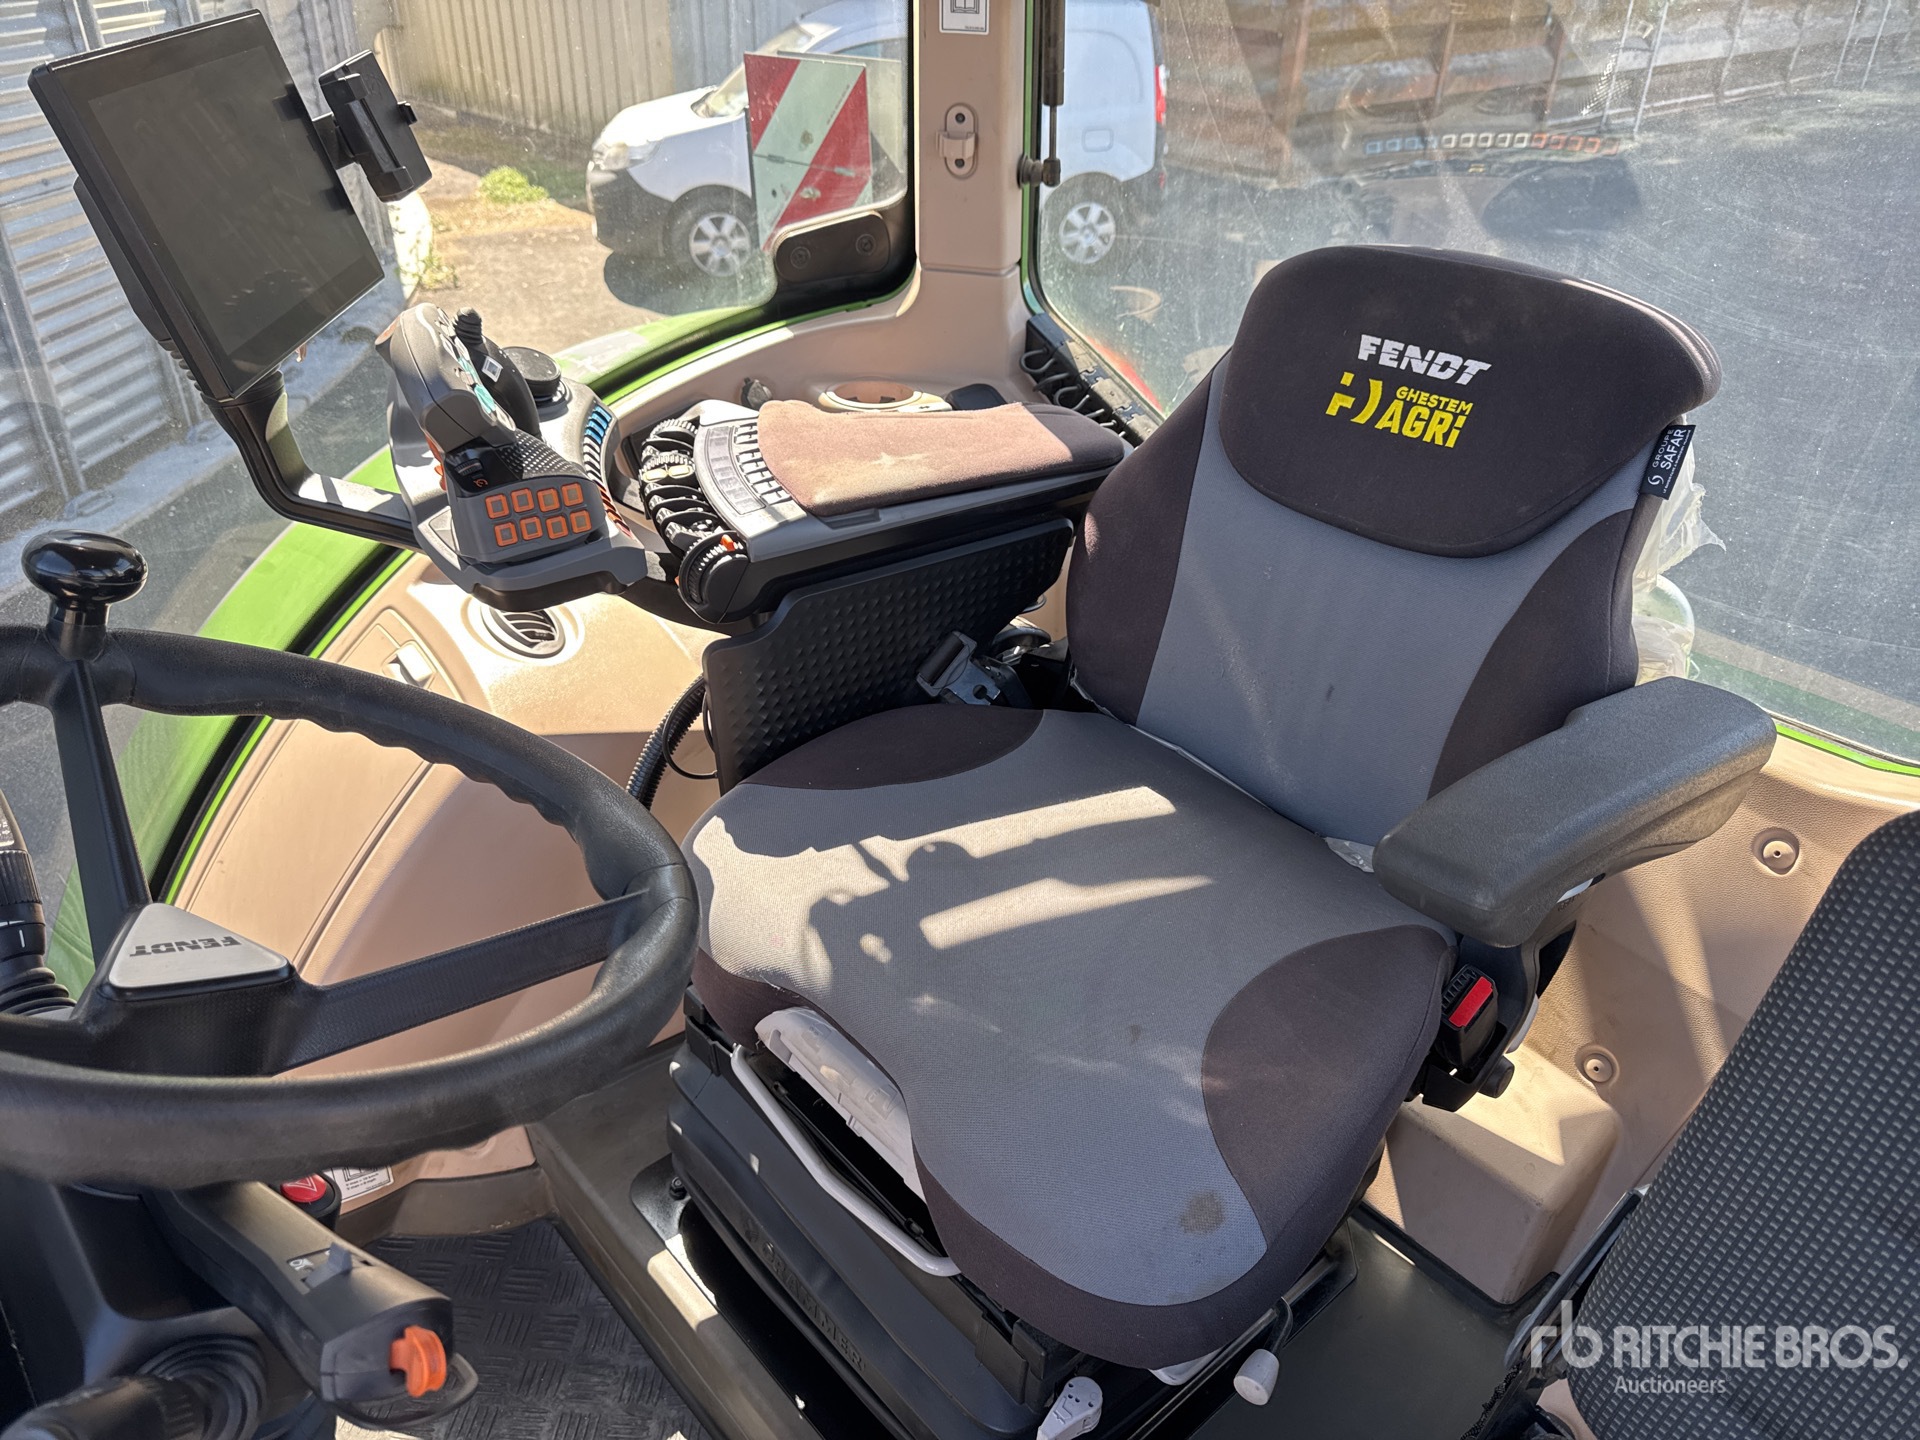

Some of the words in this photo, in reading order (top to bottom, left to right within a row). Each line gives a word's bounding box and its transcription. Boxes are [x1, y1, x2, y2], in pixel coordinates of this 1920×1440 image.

[1357, 334, 1492, 386] FENDT
[1395, 386, 1474, 415] GHESTEM
[1652, 429, 1674, 468] GROUPE
[1660, 429, 1687, 470] SAFAR
[129, 936, 242, 957] FENDT
[762, 1242, 866, 1371] GRAMMER
